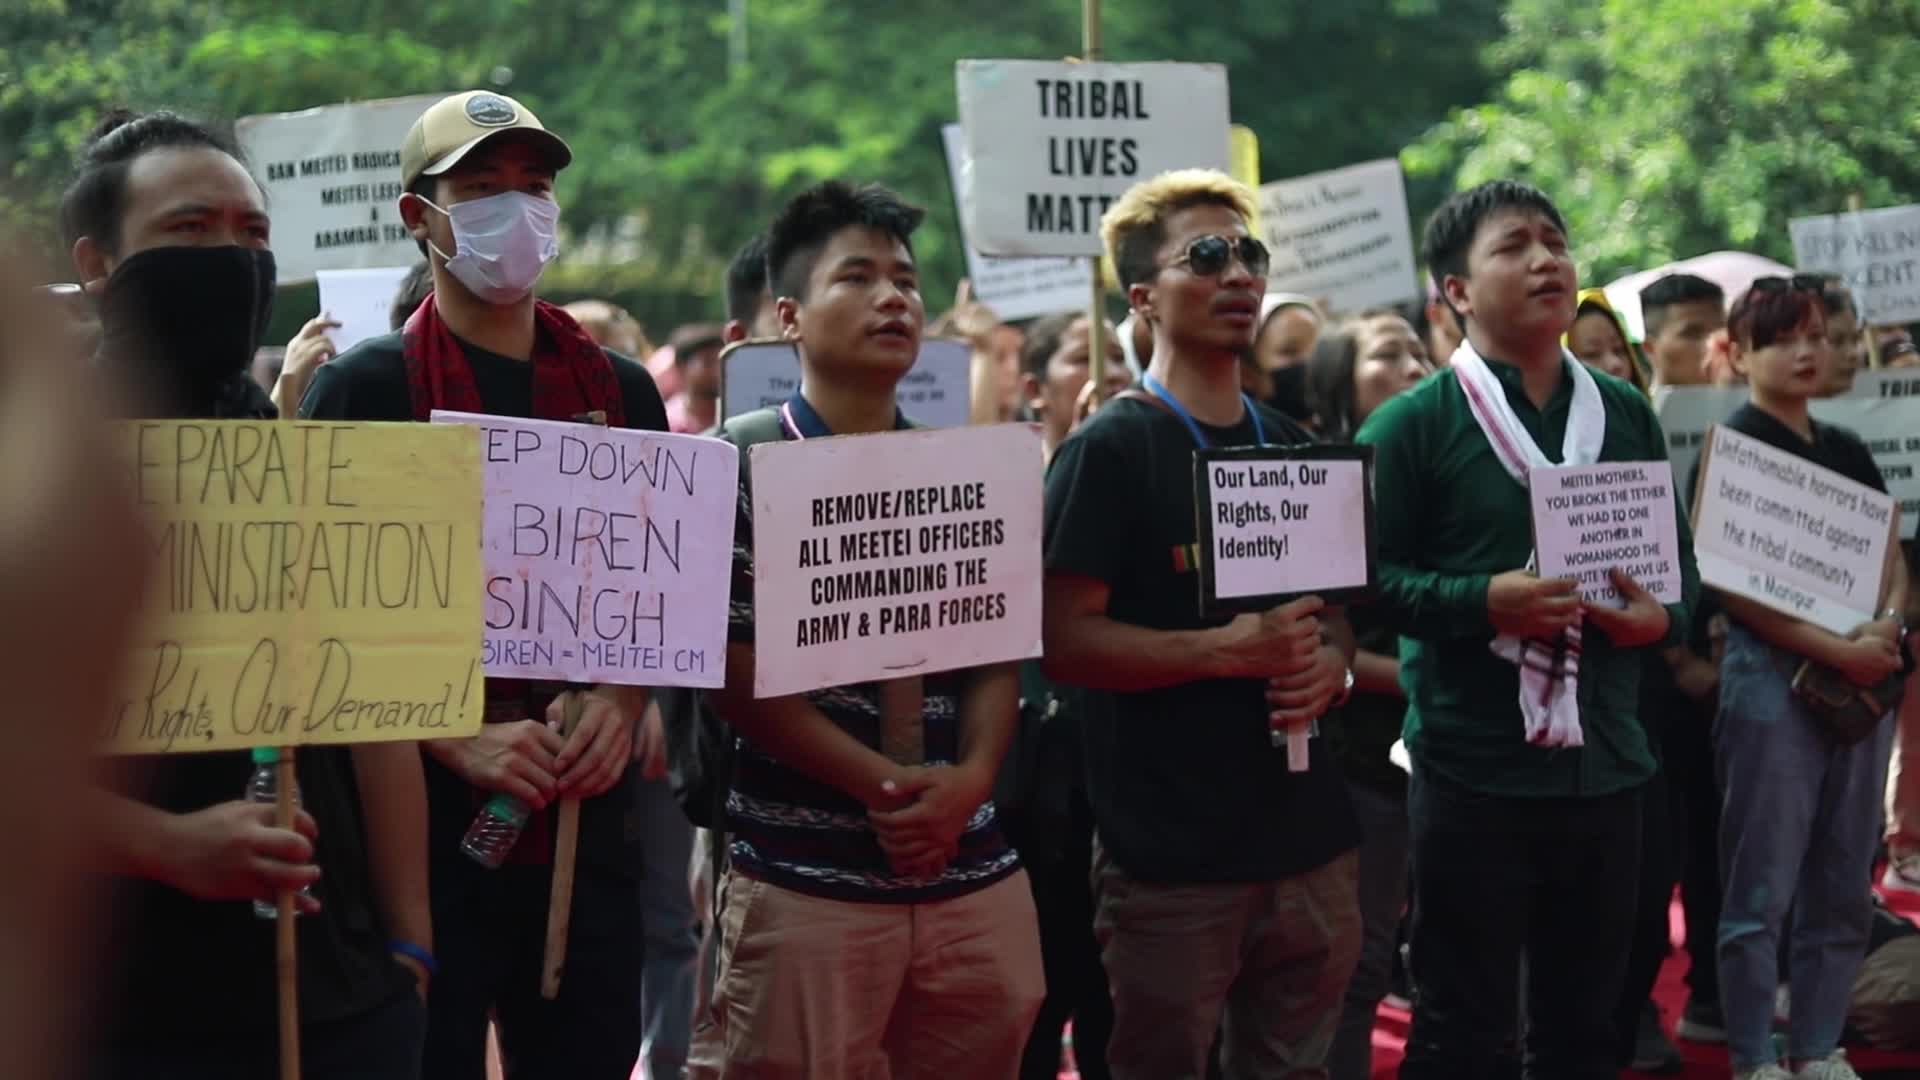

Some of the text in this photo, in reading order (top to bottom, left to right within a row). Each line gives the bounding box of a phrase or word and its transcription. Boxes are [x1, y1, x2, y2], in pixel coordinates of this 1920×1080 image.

[1036, 80, 1149, 118] TRIBAL
[352, 151, 400, 169] RADICA
[1050, 138, 1138, 176] LIVES
[1027, 193, 1118, 233] MATT
[138, 424, 358, 508] EPARATE
[481, 427, 697, 496] EP DOWN
[1215, 464, 1328, 490] Our Land, Our
[1715, 436, 1806, 489] Unfathomable
[1809, 474, 1858, 511] horrors
[1861, 498, 1889, 525] have
[1546, 486, 1666, 510] YOU BROKE THE TETHER
[1561, 474, 1593, 489] MEITEI
[812, 482, 985, 527] REMOVE/REPLACE
[1217, 499, 1309, 528] Rights, Our
[1568, 507, 1649, 527] WE HAD TO ONE
[1719, 475, 1871, 556] been committed against
[513, 503, 680, 573] BIREN
[799, 518, 1005, 568] ALL MEETEI OFFICERS
[1219, 534, 1289, 562] Identity!
[1564, 543, 1660, 567] WOMANHOOD THE
[1580, 526, 1643, 545] ANOTHER IN
[146, 522, 453, 613] MINISTRATION
[1626, 562, 1654, 576] GAVE
[1656, 560, 1670, 573] US
[1723, 520, 1856, 594] the tribal community
[811, 558, 988, 606] COMMANDING THE
[1602, 586, 1615, 599] TO
[485, 576, 664, 646] SINGH
[797, 592, 1006, 648] ARMY & PARA FORCES
[582, 643, 664, 669] MEITEI
[674, 650, 704, 673] CM
[232, 638, 296, 736] Our
[303, 637, 476, 732] Demand!
